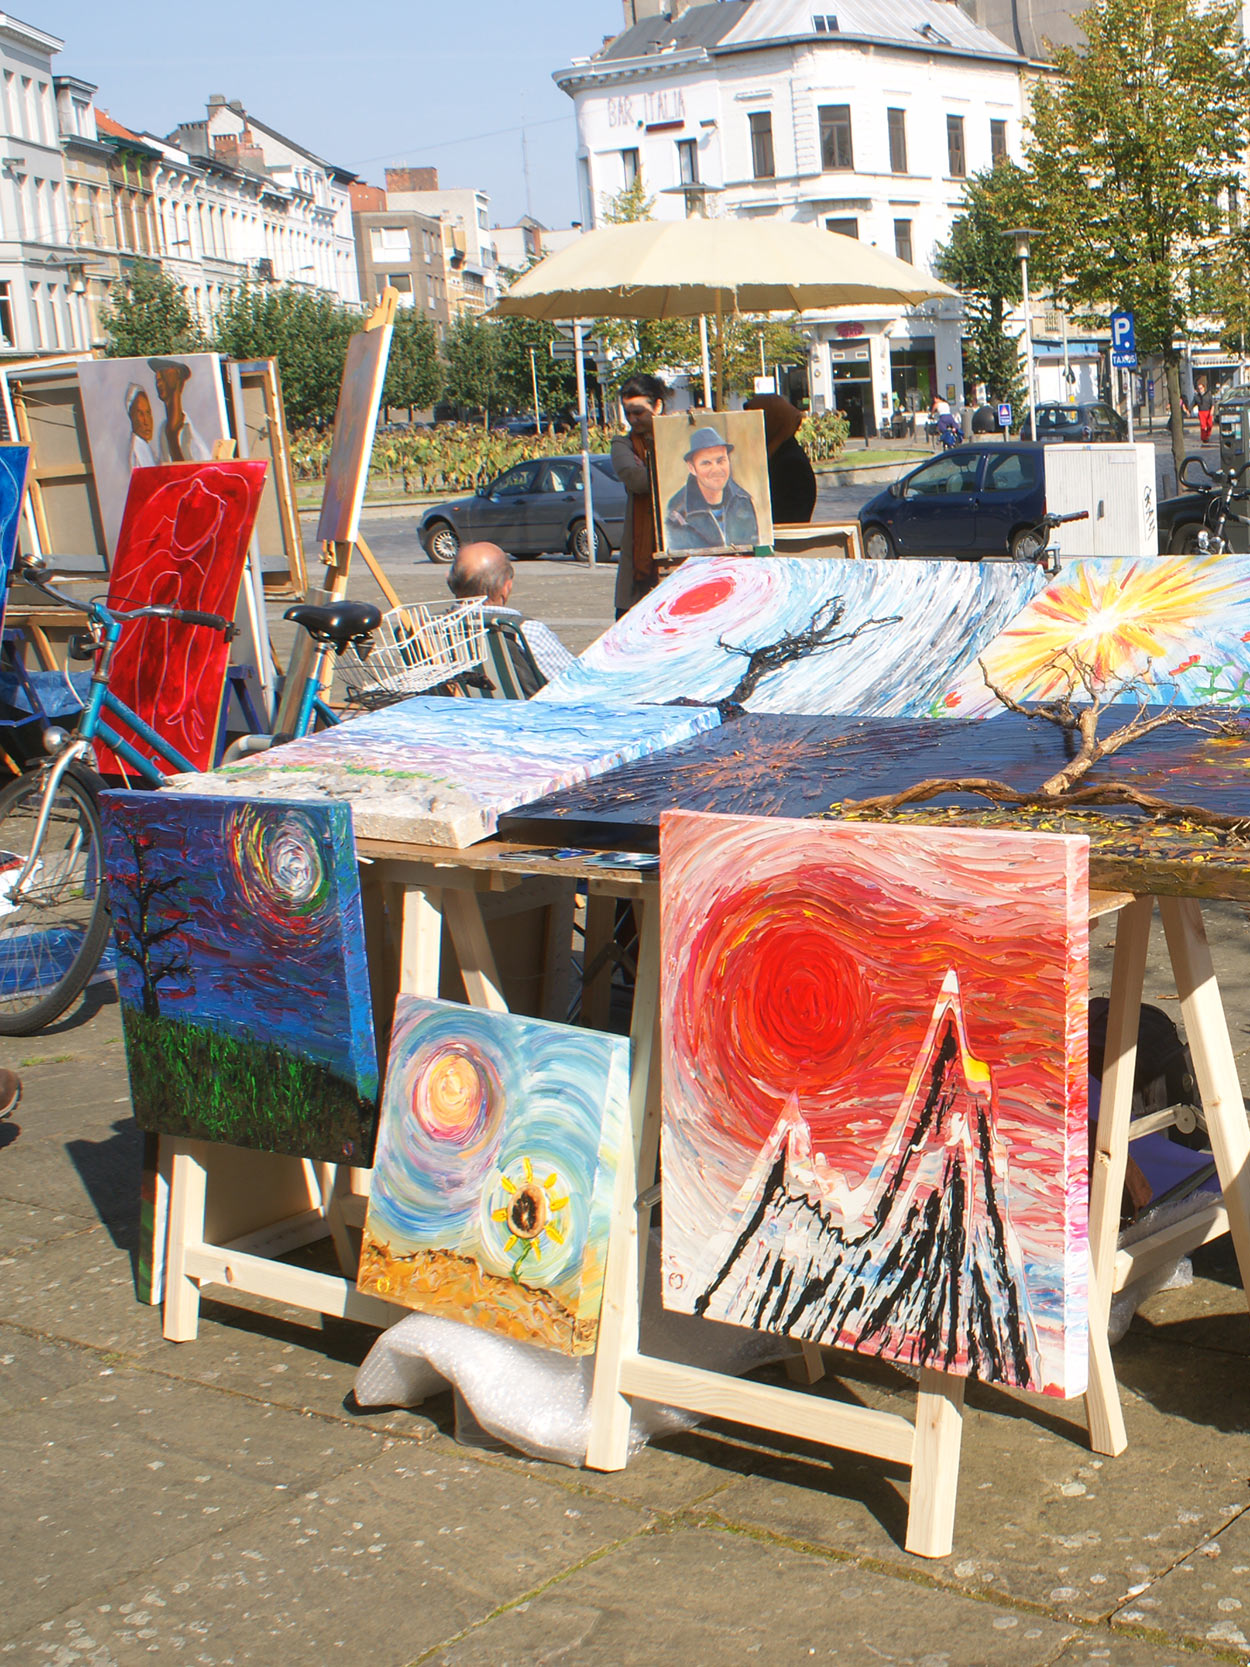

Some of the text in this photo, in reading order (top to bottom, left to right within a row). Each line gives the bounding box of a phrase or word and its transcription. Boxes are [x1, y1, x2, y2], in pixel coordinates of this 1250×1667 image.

[608, 90, 686, 128] BAR ITALIA
[1114, 317, 1130, 346] P
